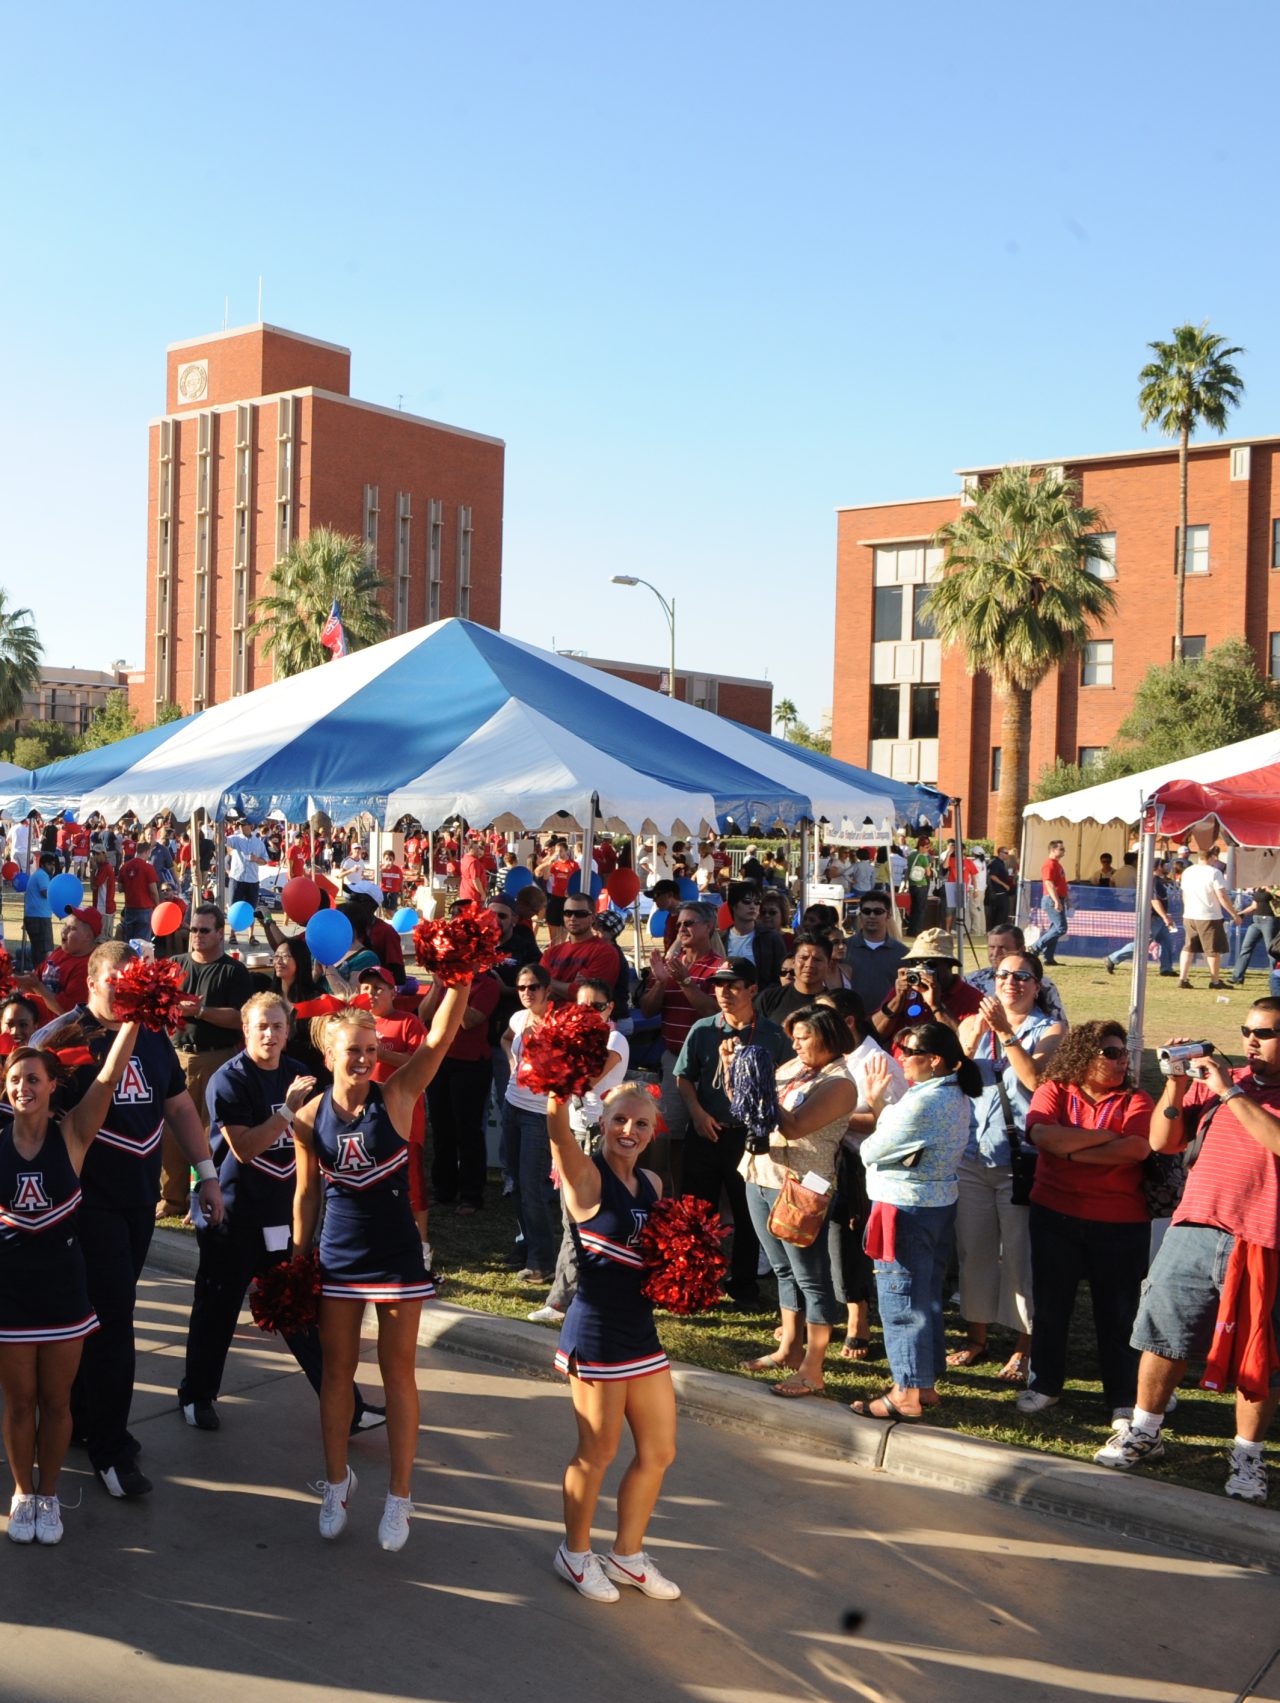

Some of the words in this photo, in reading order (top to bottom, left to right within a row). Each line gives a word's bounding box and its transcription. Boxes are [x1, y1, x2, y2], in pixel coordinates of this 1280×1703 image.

[113, 1056, 152, 1104] A
[334, 1132, 377, 1173] A
[11, 1172, 52, 1211] A
